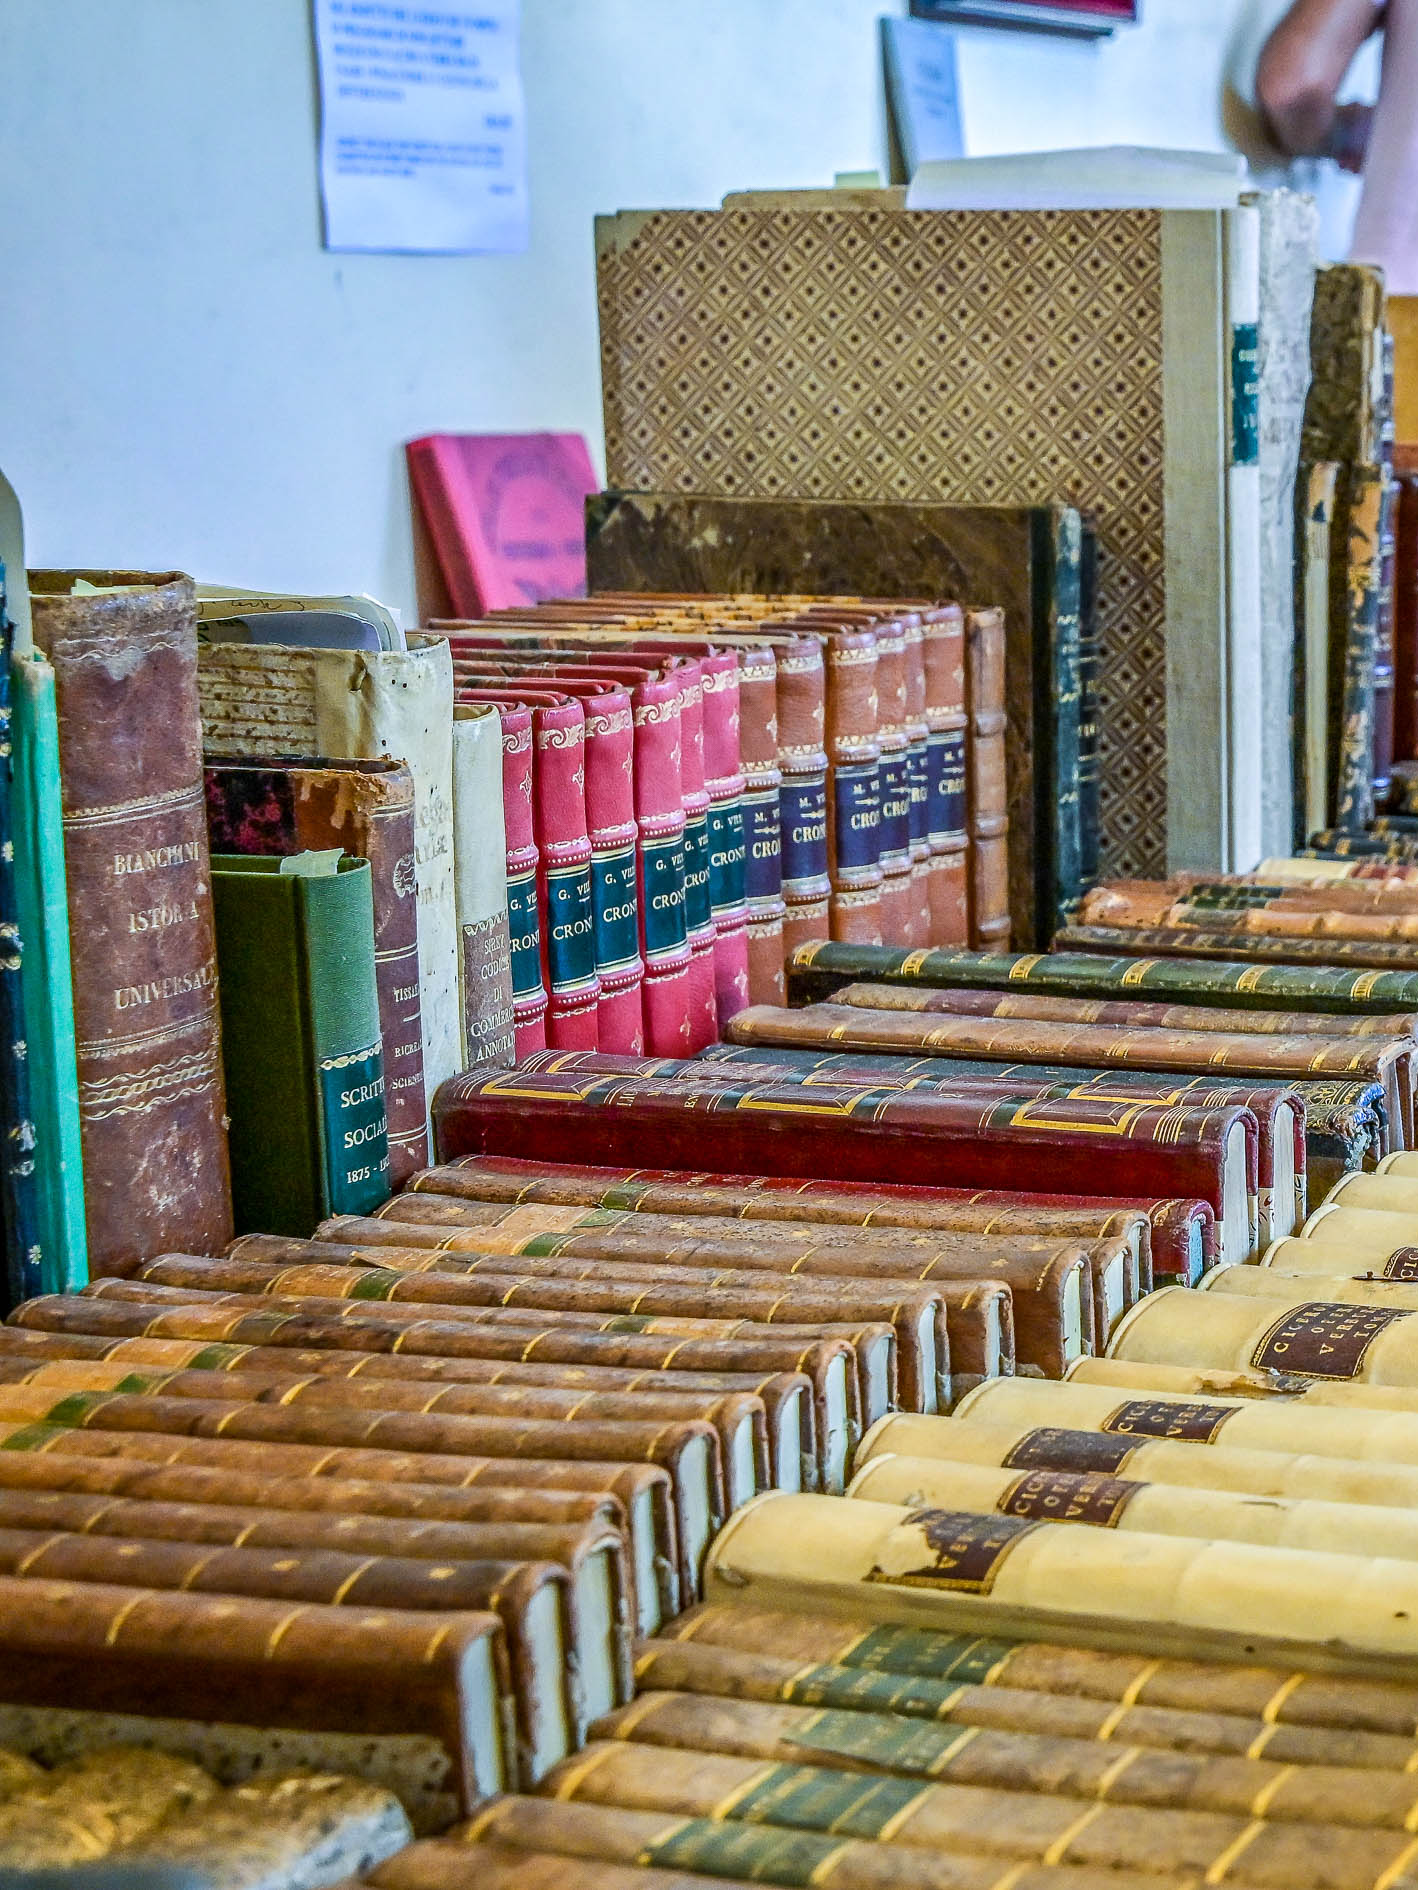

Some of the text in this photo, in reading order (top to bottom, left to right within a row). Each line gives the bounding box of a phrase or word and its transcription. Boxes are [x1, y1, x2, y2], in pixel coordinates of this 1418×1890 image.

[113, 841, 200, 875] BIANCHINI
[604, 873, 617, 885] G.
[558, 889, 571, 901] G.
[510, 899, 522, 911] G.
[493, 986, 503, 1003] DI
[346, 1165, 371, 1185] 1875
